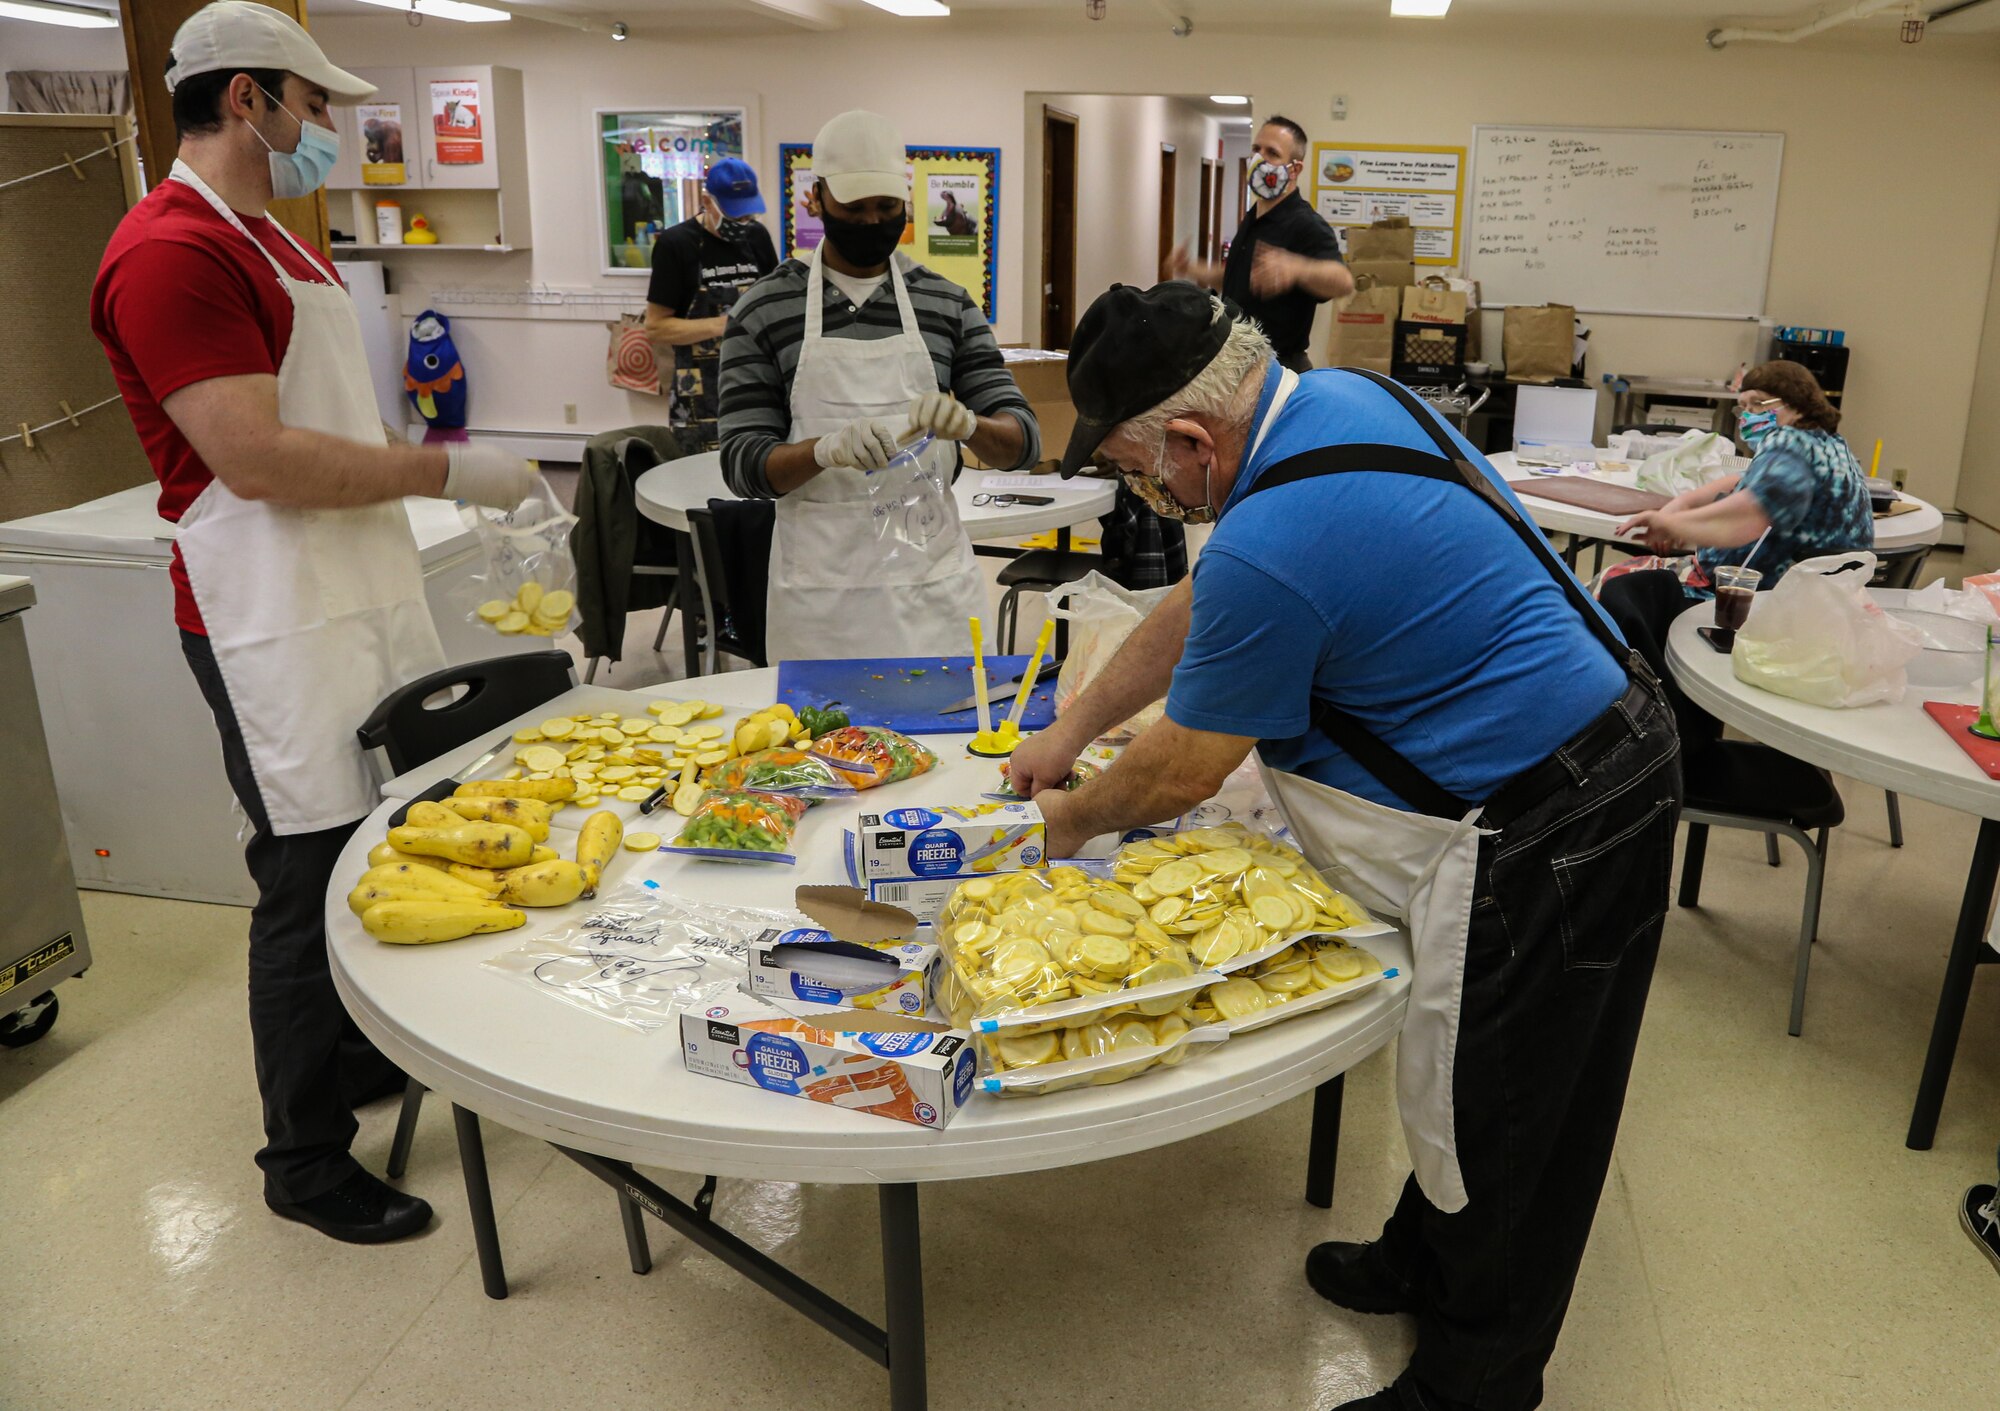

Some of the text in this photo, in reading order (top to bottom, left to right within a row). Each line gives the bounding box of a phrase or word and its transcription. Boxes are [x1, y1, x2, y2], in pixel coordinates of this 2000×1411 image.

[452, 88, 477, 99] Kindly
[615, 128, 729, 157] welcome
[930, 179, 976, 188] Be Humble
[917, 848, 956, 861] FREEZER
[870, 859, 880, 867] 19
[755, 975, 764, 983] 19
[711, 1027, 736, 1038] Essential
[687, 1042, 698, 1052] 10
[760, 1045, 793, 1058] GALLON
[754, 1051, 801, 1073] FREEZER
[767, 1069, 789, 1079] SLIDER
